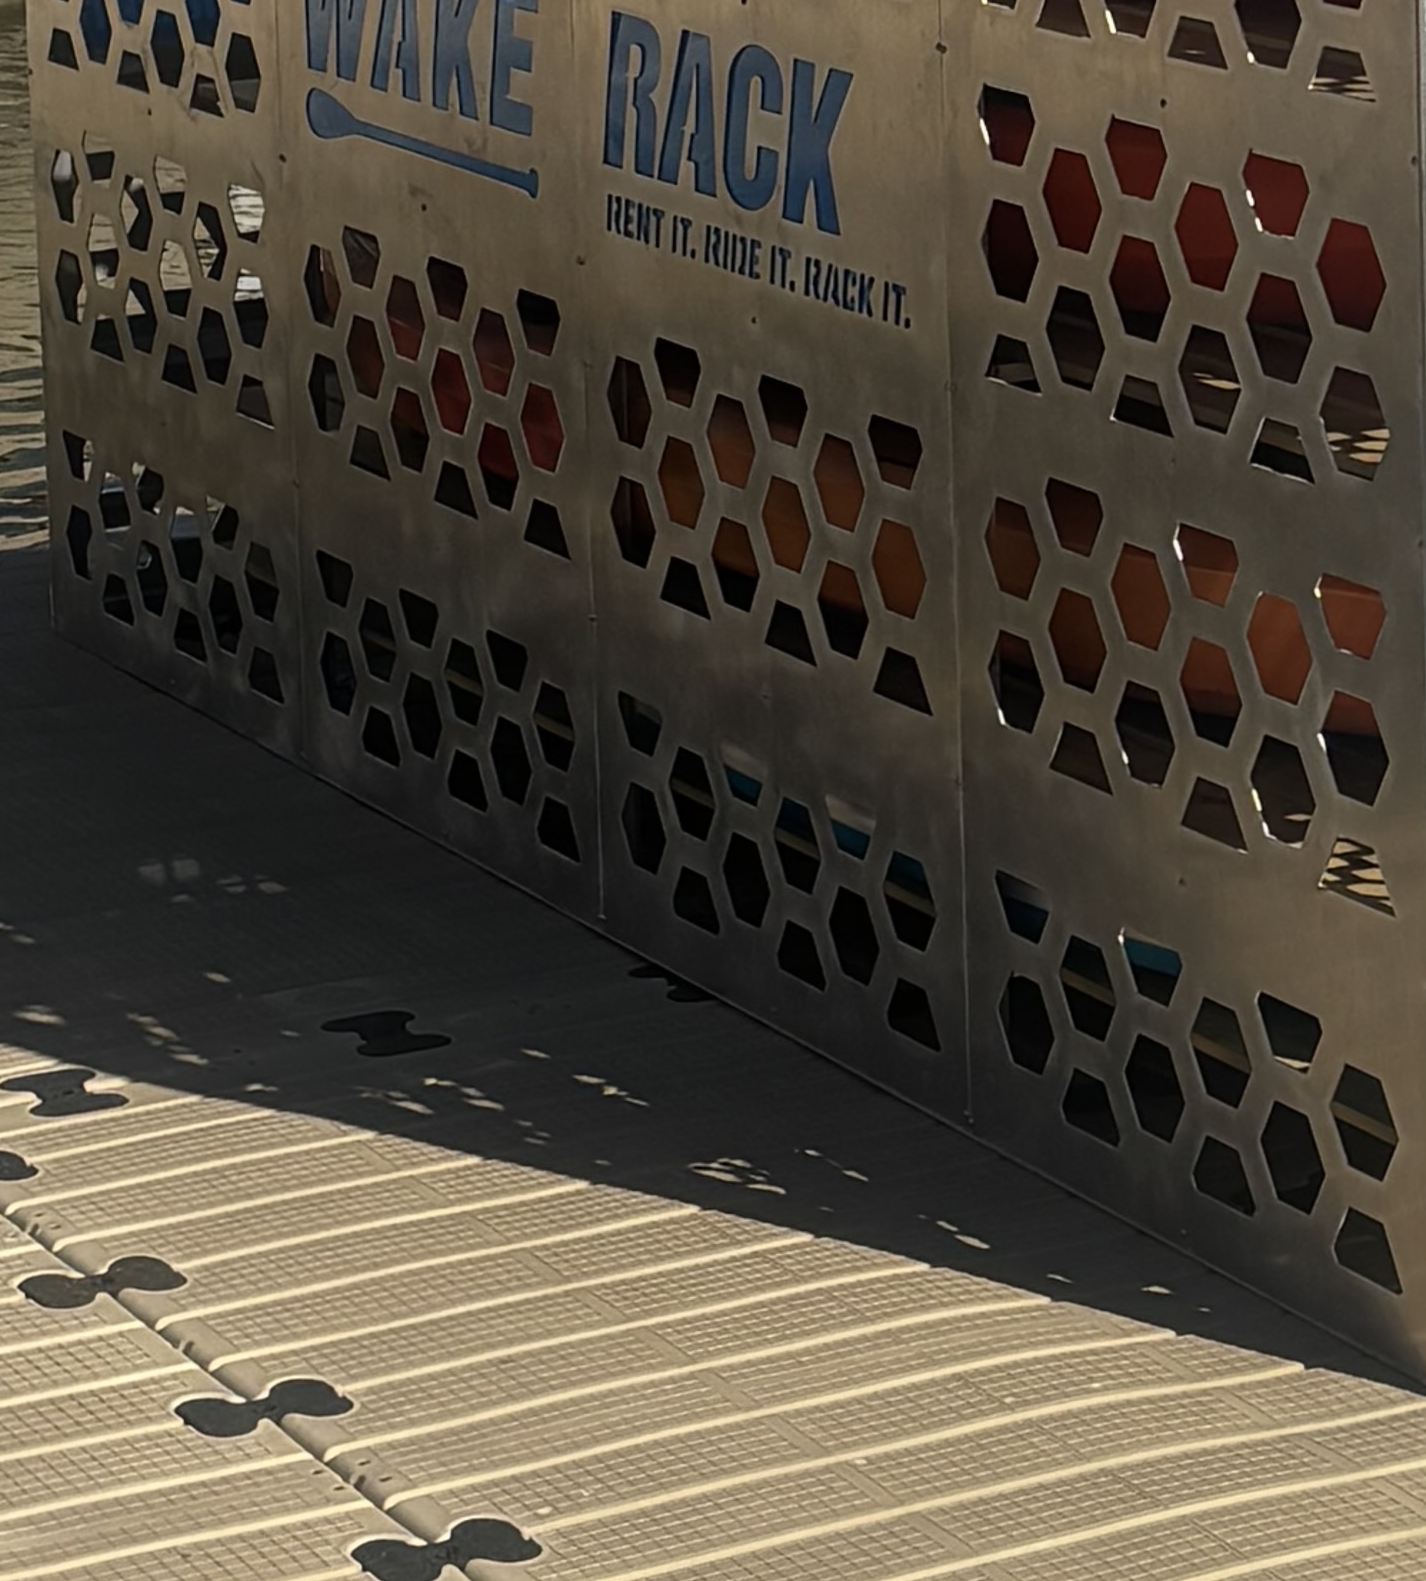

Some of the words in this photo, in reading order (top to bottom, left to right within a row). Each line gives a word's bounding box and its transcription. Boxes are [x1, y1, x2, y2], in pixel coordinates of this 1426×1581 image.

[602, 9, 855, 236] RACK
[606, 193, 665, 249] RENT
[671, 214, 696, 260] IT.
[704, 224, 763, 281] RIDE
[769, 244, 796, 293] IT.
[804, 256, 876, 318] RACK
[882, 280, 912, 330] IT.
